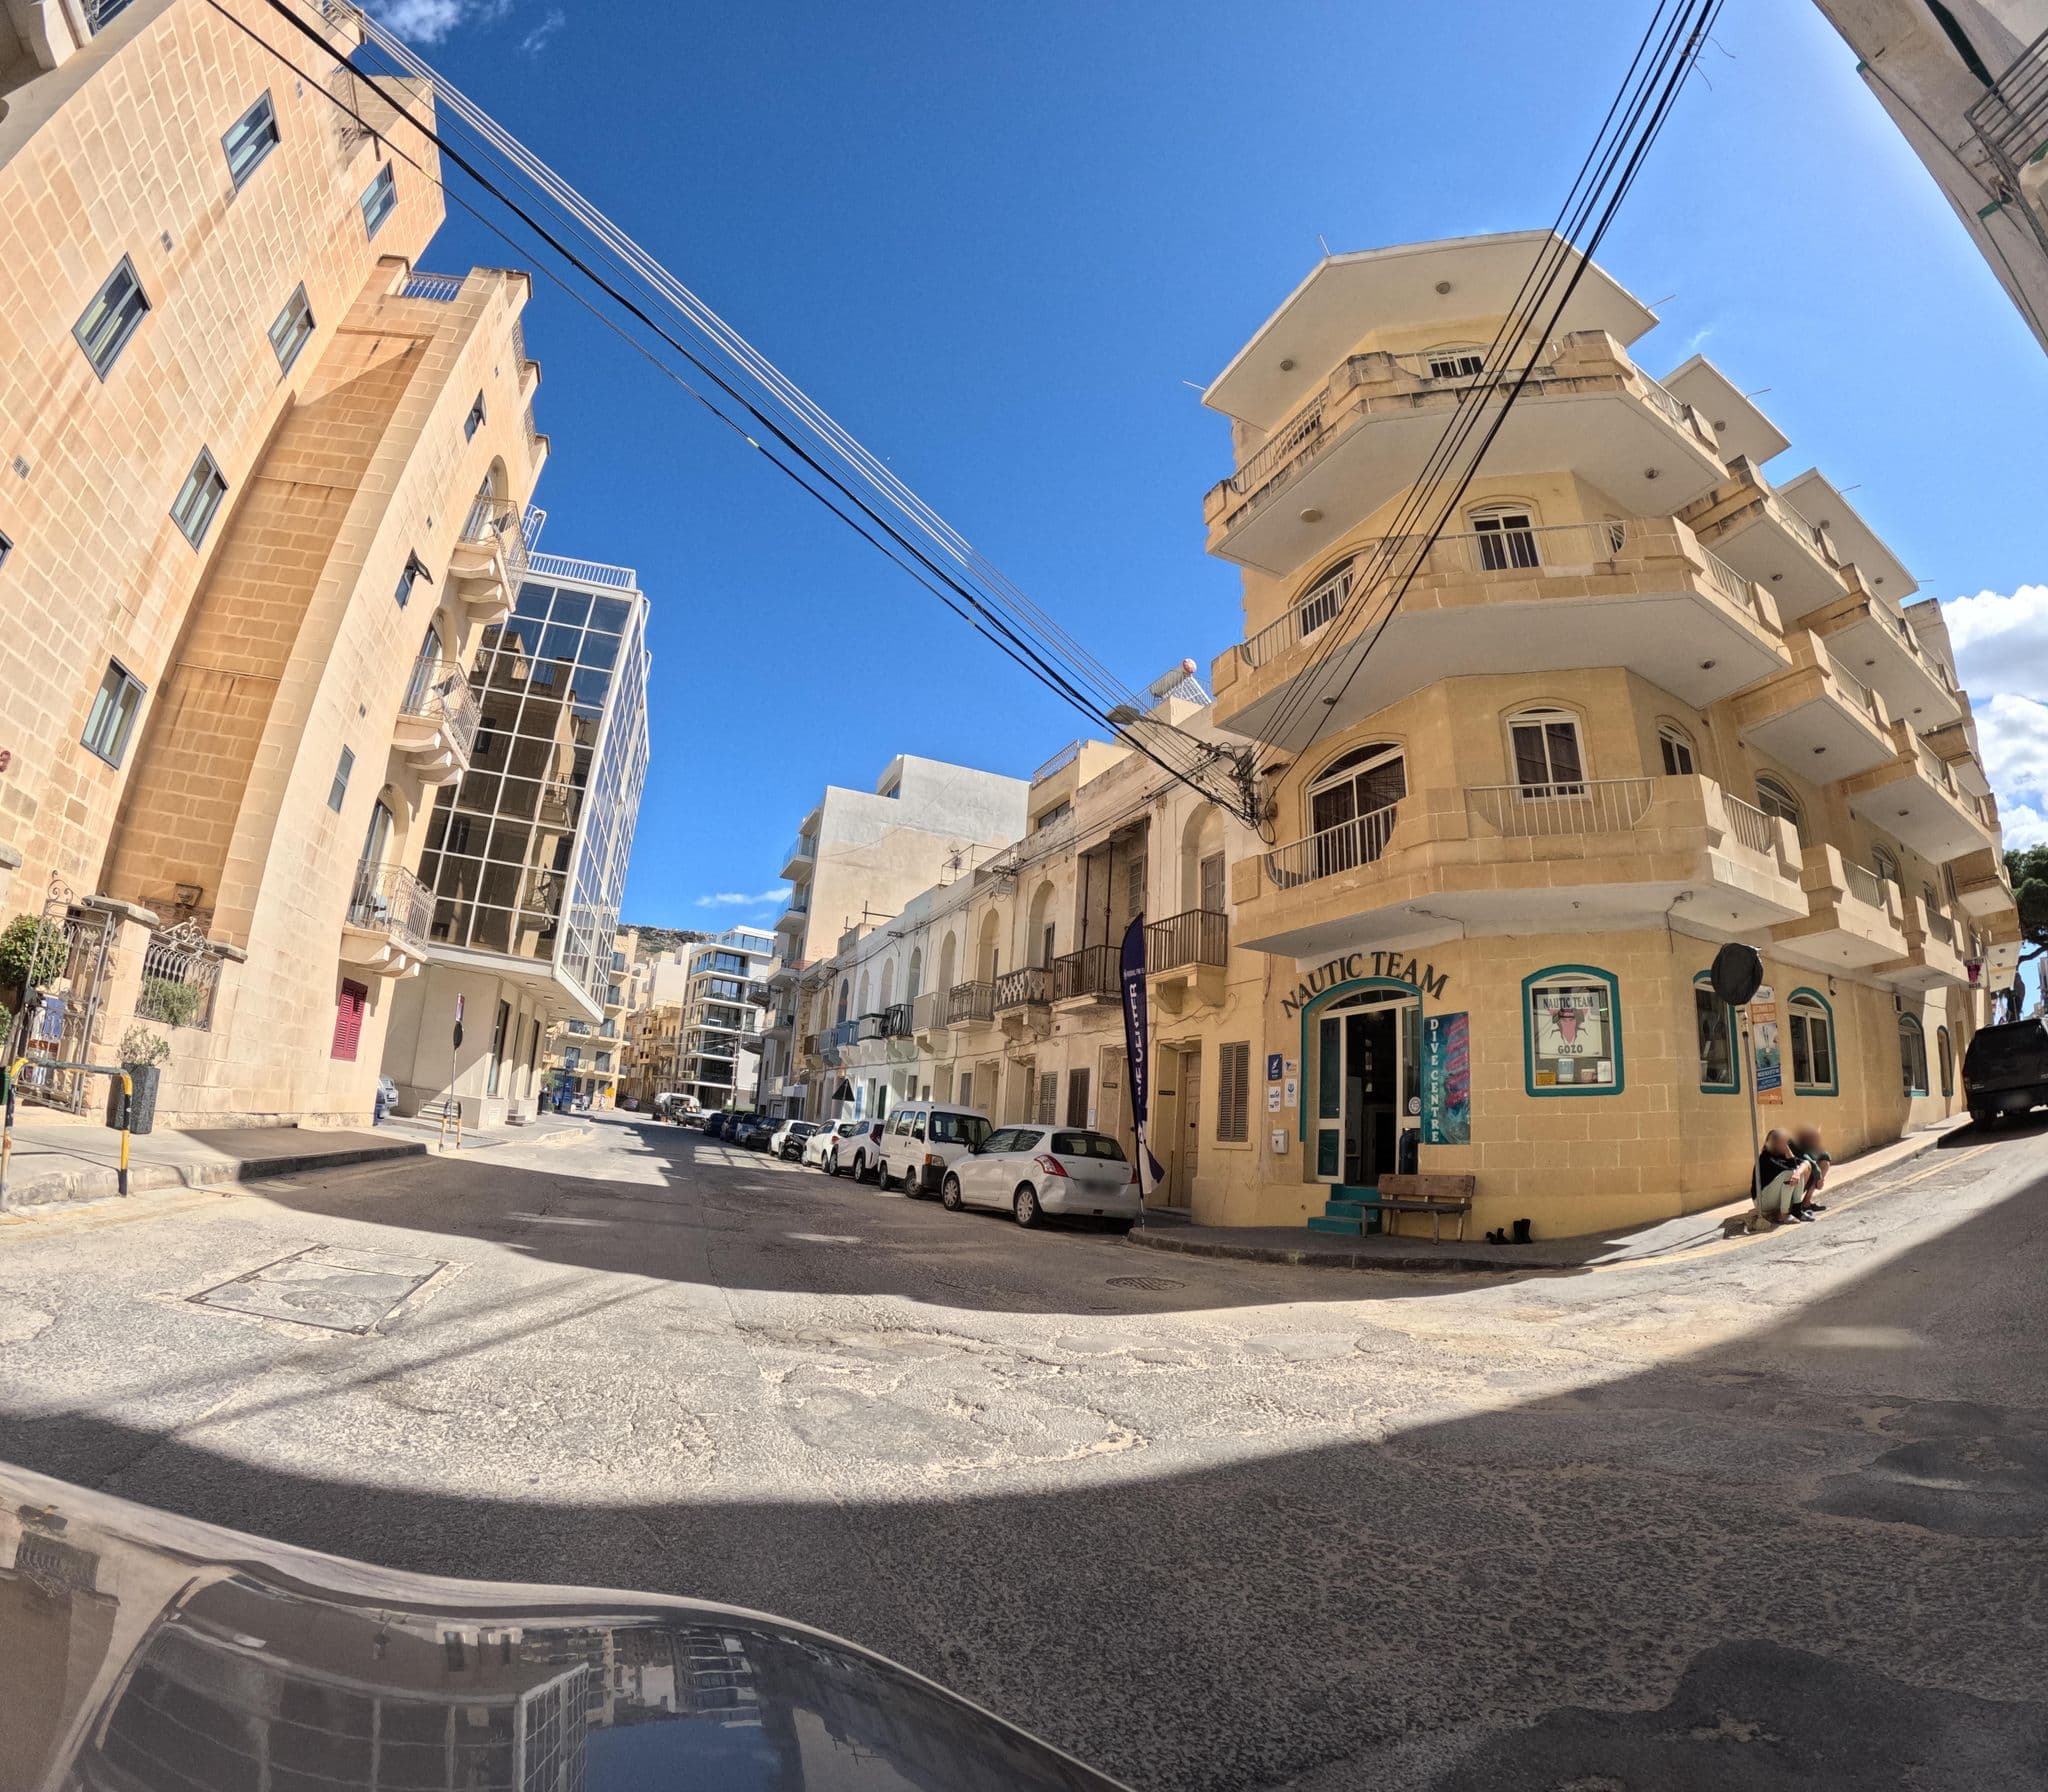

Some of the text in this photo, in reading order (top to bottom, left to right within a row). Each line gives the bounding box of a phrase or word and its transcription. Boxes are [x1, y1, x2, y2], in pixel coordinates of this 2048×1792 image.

[1280, 951, 1449, 1018] NAUTIC TEAM
[1543, 996, 1594, 1009] NAUTIC TEAM
[1557, 1044, 1583, 1054] GOZO
[1430, 1019, 1440, 1142] DIVE CENTRE
